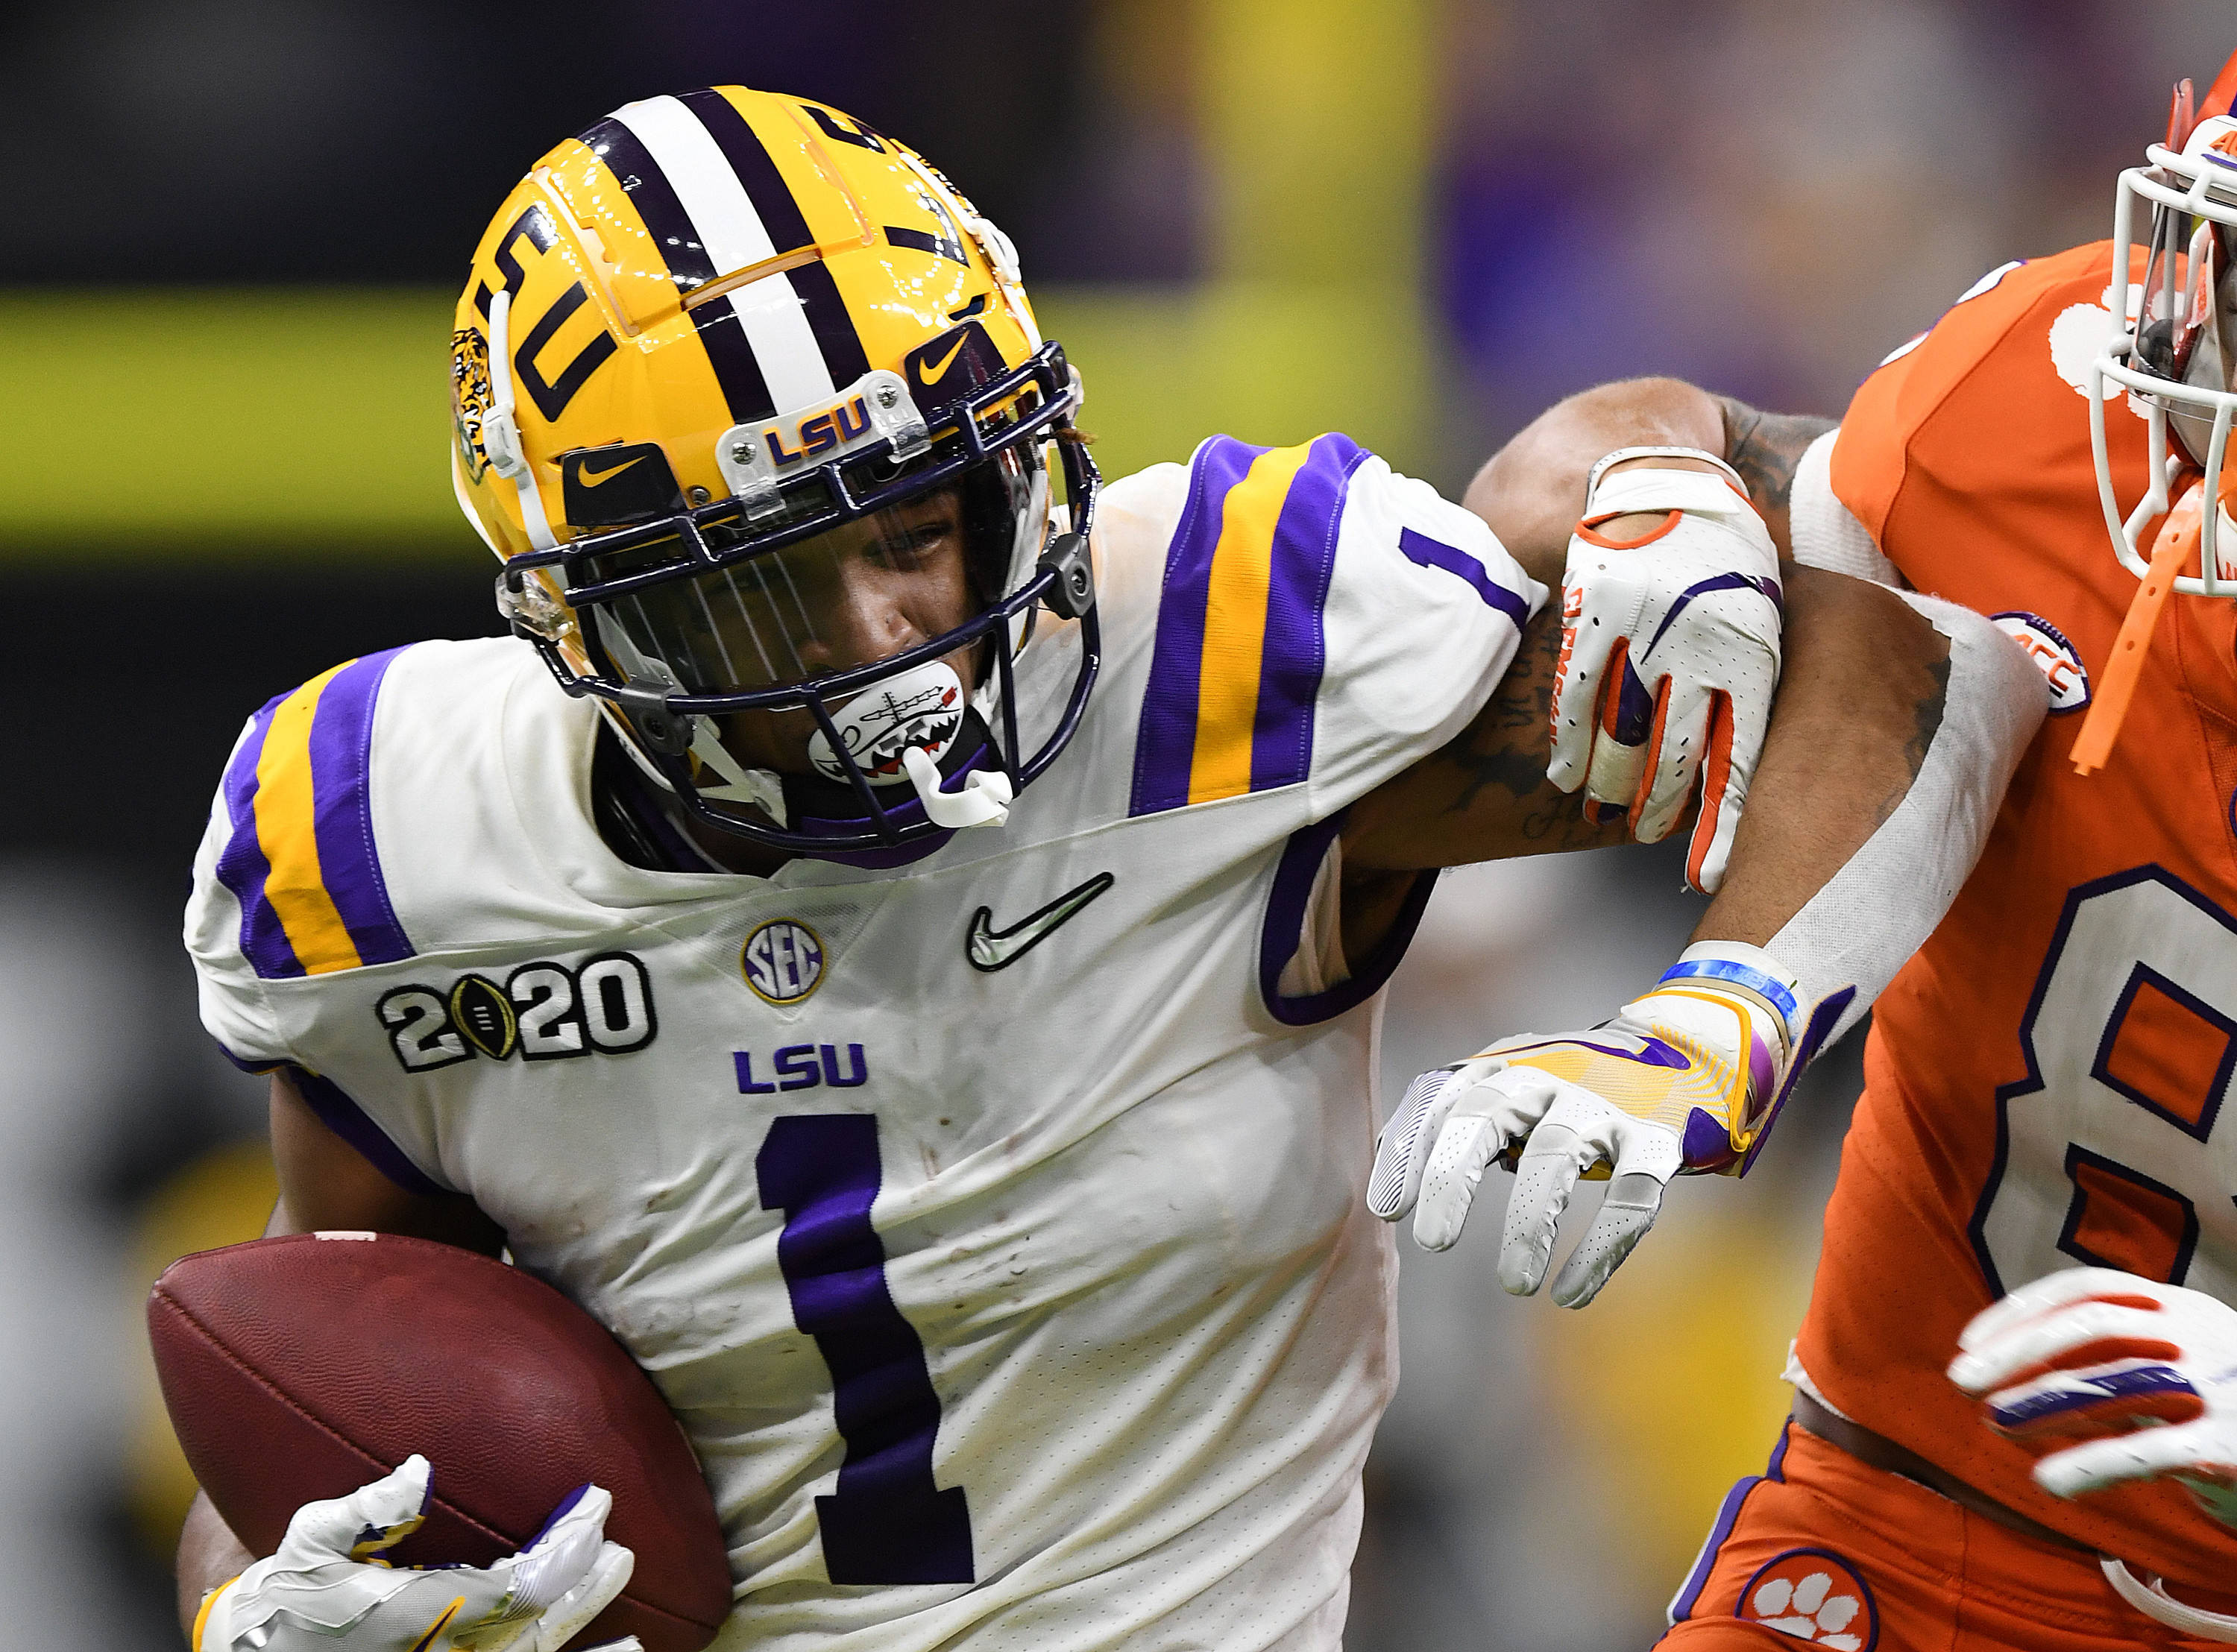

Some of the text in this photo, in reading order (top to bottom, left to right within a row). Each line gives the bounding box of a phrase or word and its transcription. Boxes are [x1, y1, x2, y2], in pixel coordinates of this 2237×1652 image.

[763, 393, 872, 467] LSU
[1398, 526, 1532, 635] 1
[746, 923, 821, 999] SEC
[374, 950, 658, 1074] 2020
[732, 1043, 869, 1094] LSU
[755, 1113, 975, 1585] 1
